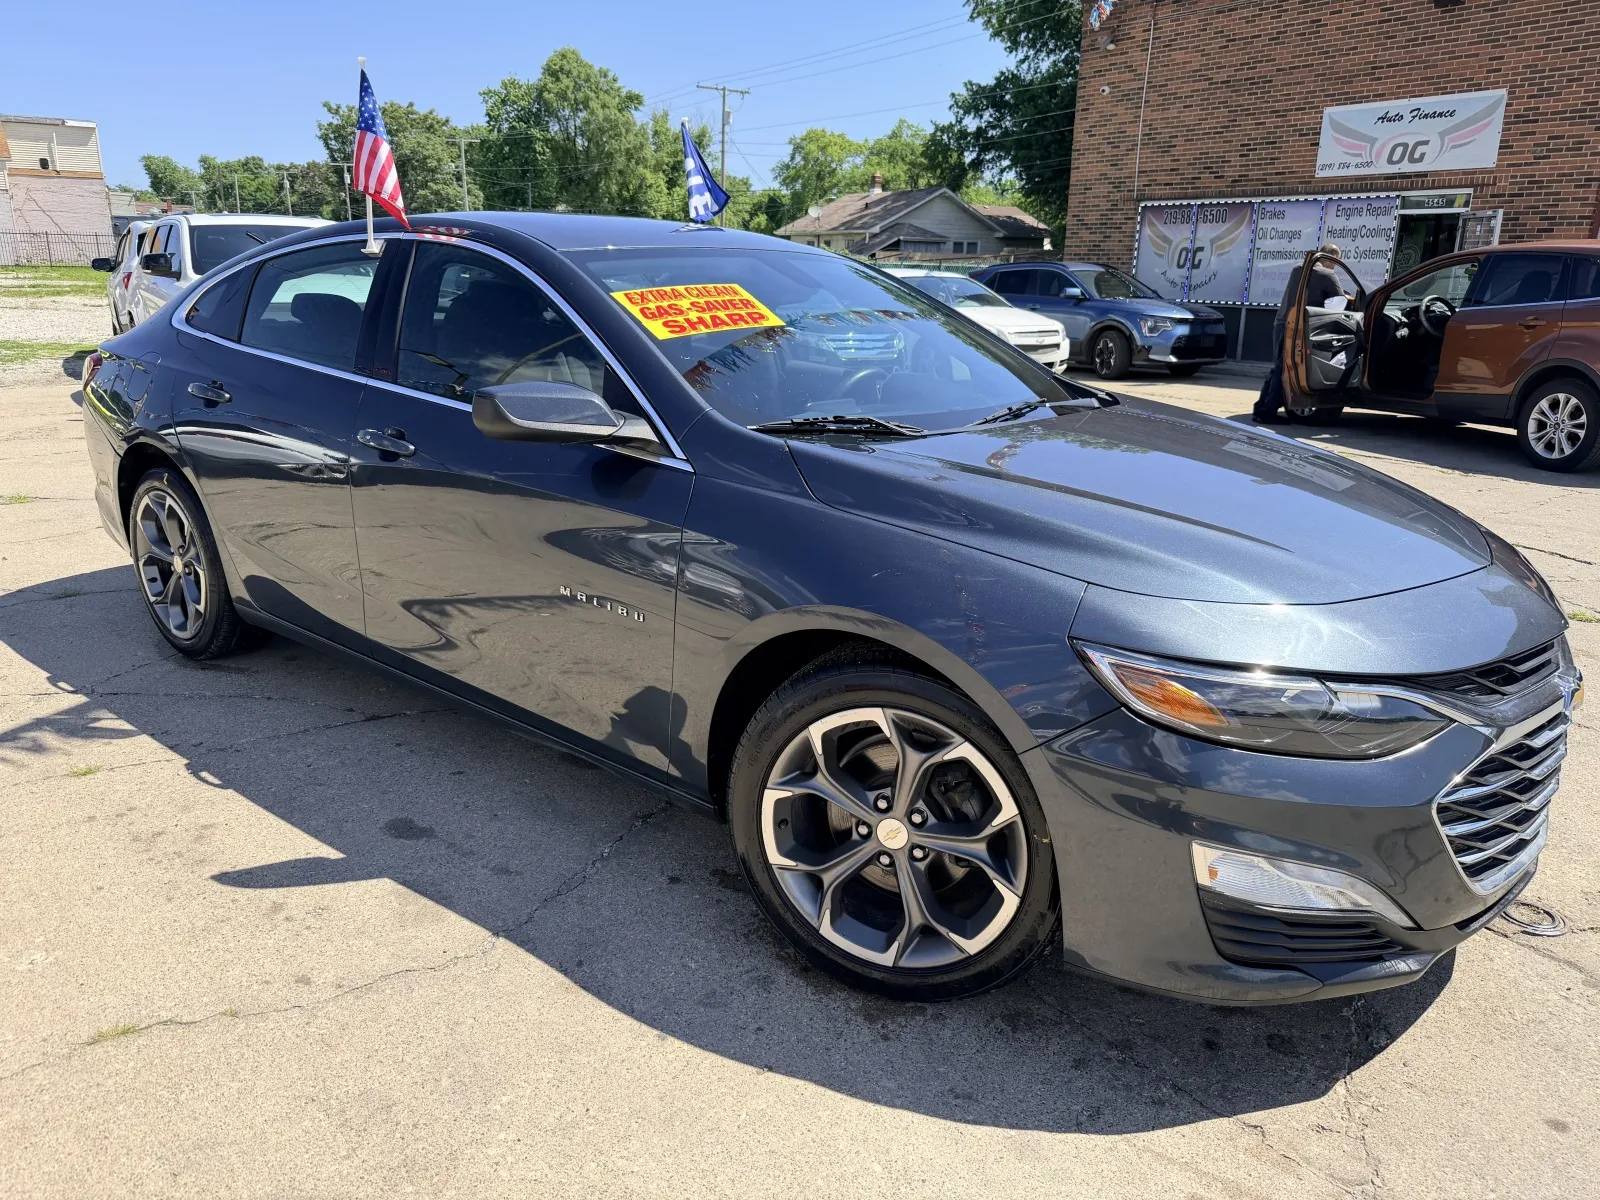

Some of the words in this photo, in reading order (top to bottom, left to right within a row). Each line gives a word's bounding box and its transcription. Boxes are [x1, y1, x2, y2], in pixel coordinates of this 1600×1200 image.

[1374, 110, 1403, 125] Auto
[1408, 108, 1456, 123] Finance
[1386, 139, 1431, 166] OG
[1318, 163, 1335, 171] (219)
[1337, 160, 1374, 170] 884-6500
[1425, 198, 1446, 206] 4545
[1164, 208, 1228, 225] 219-88-6500
[1260, 207, 1286, 220] Brakes
[1335, 204, 1363, 220] Engine
[1365, 203, 1394, 219] Repair
[1258, 227, 1268, 240] Oil
[1269, 227, 1302, 243] Changes
[1326, 225, 1392, 242] Heating/Cooling
[1176, 246, 1205, 269] OG
[1256, 247, 1307, 260] Transmissions
[1353, 246, 1389, 263] Systems
[1161, 270, 1178, 288] Auto
[623, 288, 683, 306] EXTRA
[684, 285, 742, 300] CLEAN
[639, 298, 761, 321] GAS-SAVER
[662, 311, 769, 335] SHARP
[560, 585, 645, 622] MALIBU
